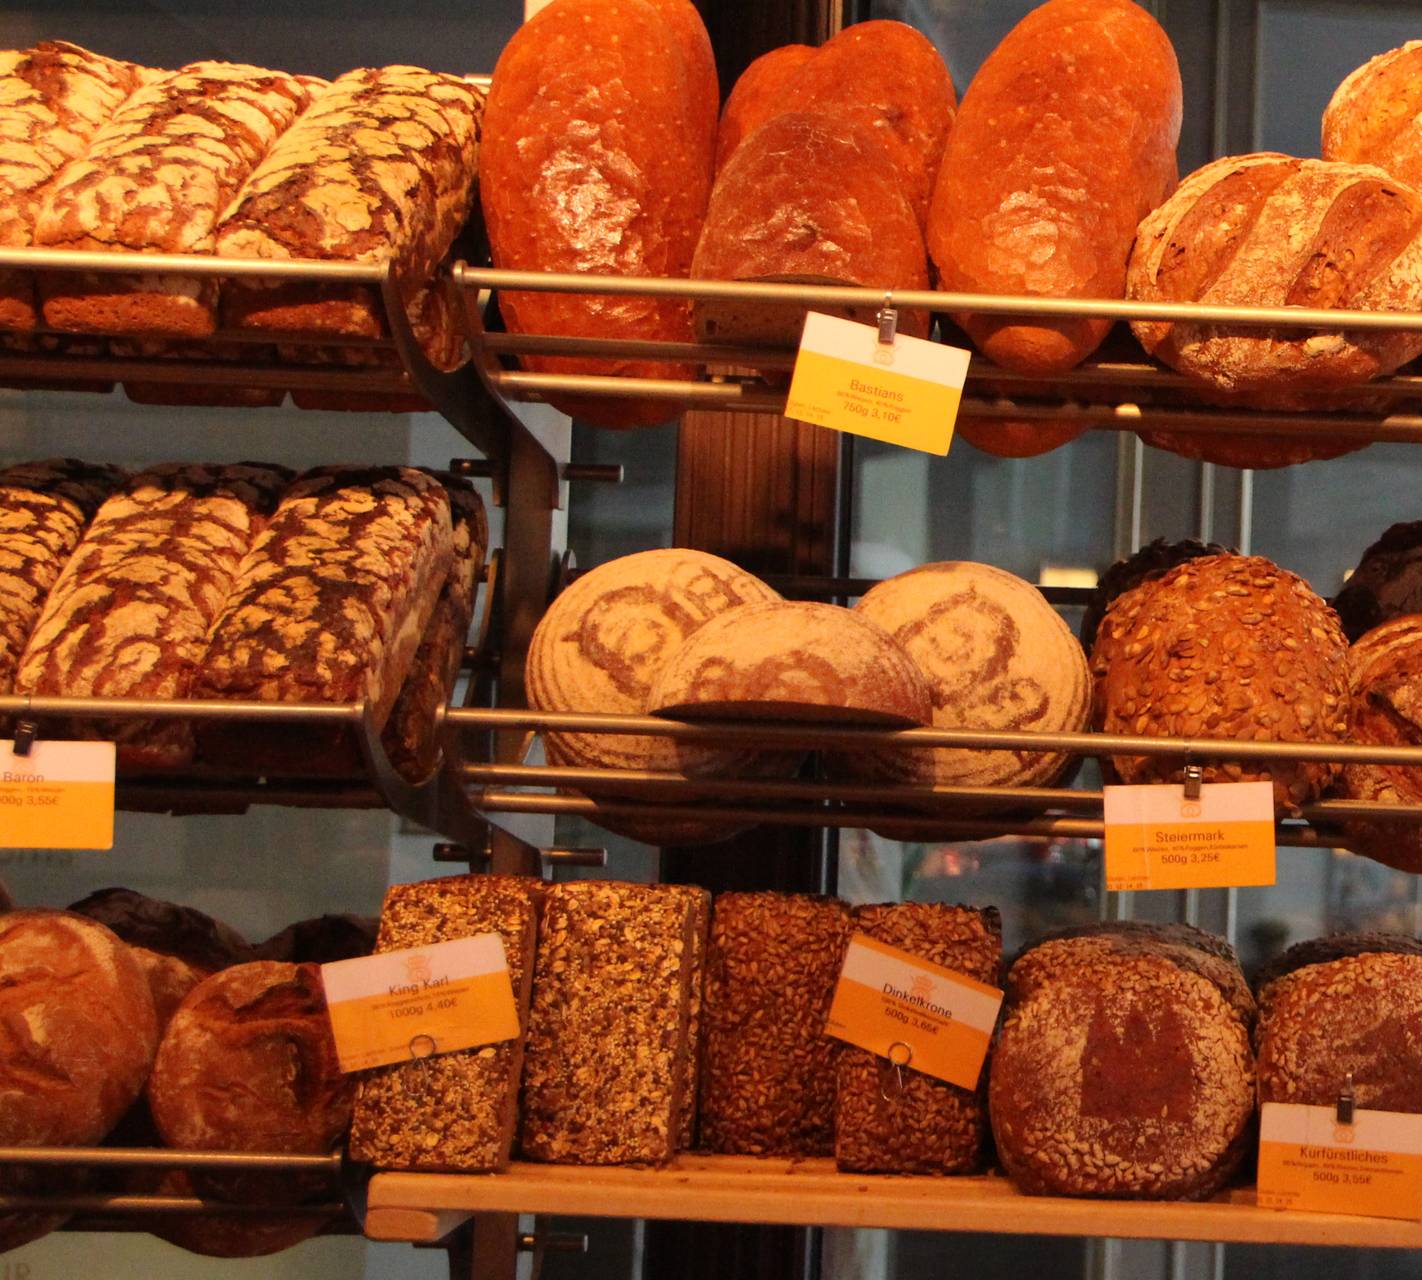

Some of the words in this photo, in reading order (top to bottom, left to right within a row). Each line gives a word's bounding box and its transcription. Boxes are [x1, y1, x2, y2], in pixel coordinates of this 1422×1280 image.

[849, 379, 904, 401] Bastians
[843, 400, 869, 417] 750g
[871, 408, 902, 424] 3,10€
[3, 771, 45, 783] Baron
[0, 795, 23, 806] 00g
[26, 795, 60, 807] 3,55€
[1155, 830, 1225, 844] Steiermark
[1161, 854, 1188, 865] 500g
[1190, 852, 1221, 864] 3,25€
[388, 981, 419, 997] King
[422, 976, 449, 991] Karl
[883, 982, 953, 1018] Dinkelkrone
[390, 1005, 424, 1020] 1000g
[885, 1007, 909, 1025] 500g
[1299, 1147, 1389, 1164] Kurfürstliches
[1313, 1171, 1340, 1184] 500g
